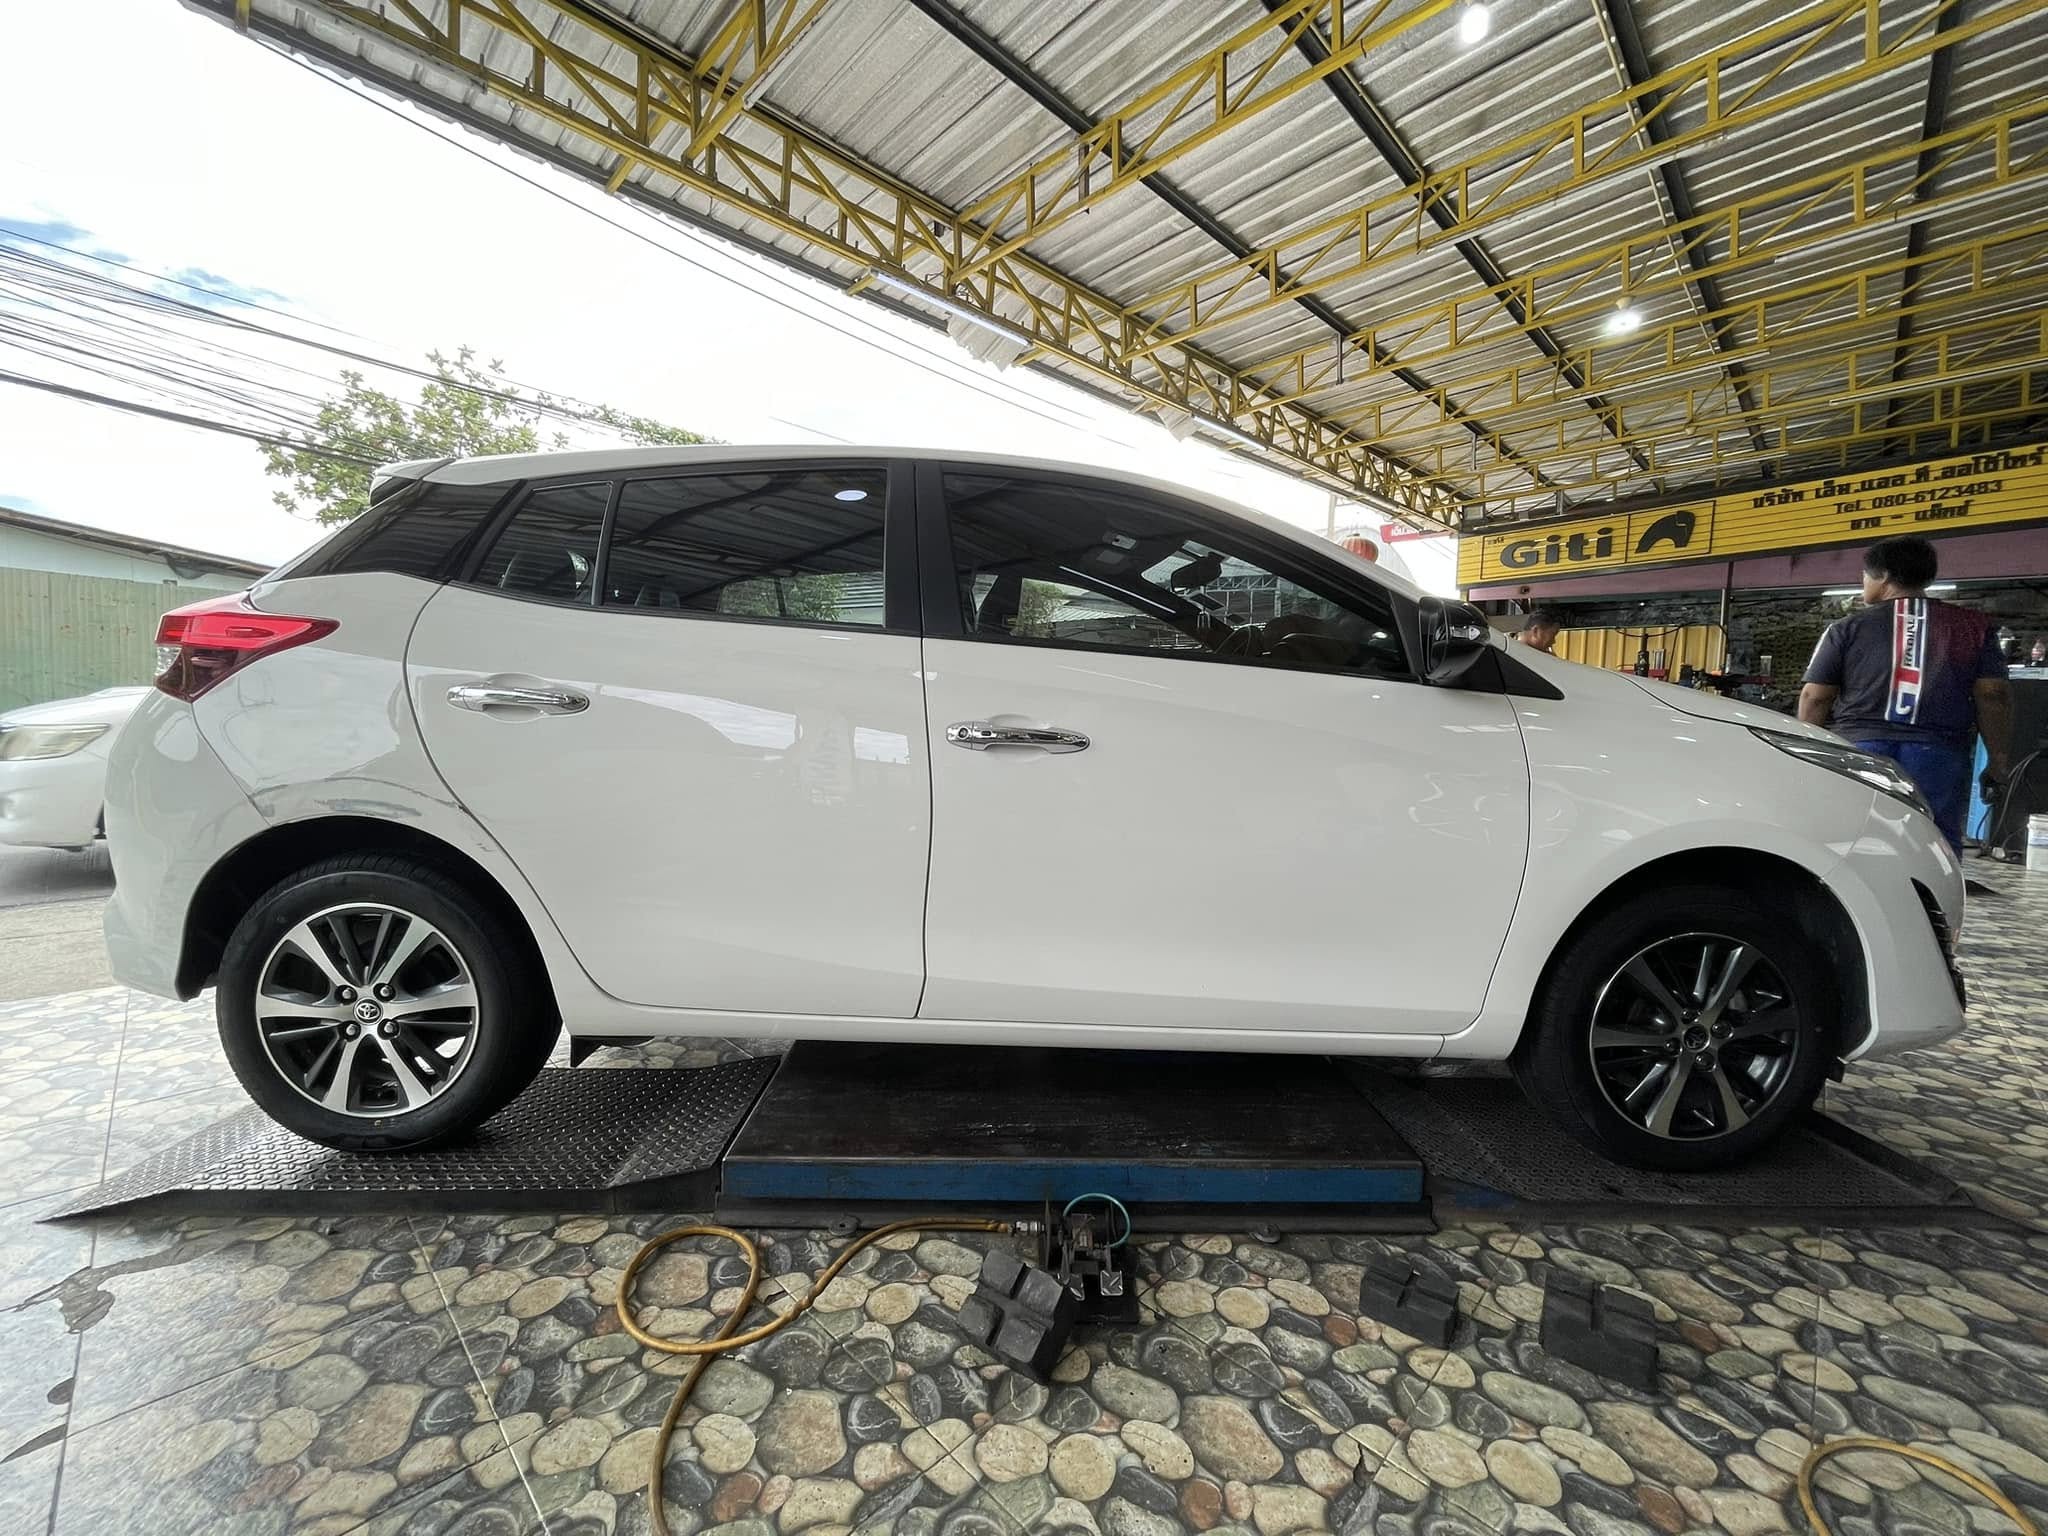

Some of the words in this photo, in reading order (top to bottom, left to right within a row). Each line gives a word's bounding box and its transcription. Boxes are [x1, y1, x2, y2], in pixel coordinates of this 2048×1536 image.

[1753, 488, 1804, 508] บริษัท
[1872, 480, 2002, 508] 080-6123483
[1500, 527, 1614, 569] Giti
[1903, 619, 1918, 668] RADIAL
